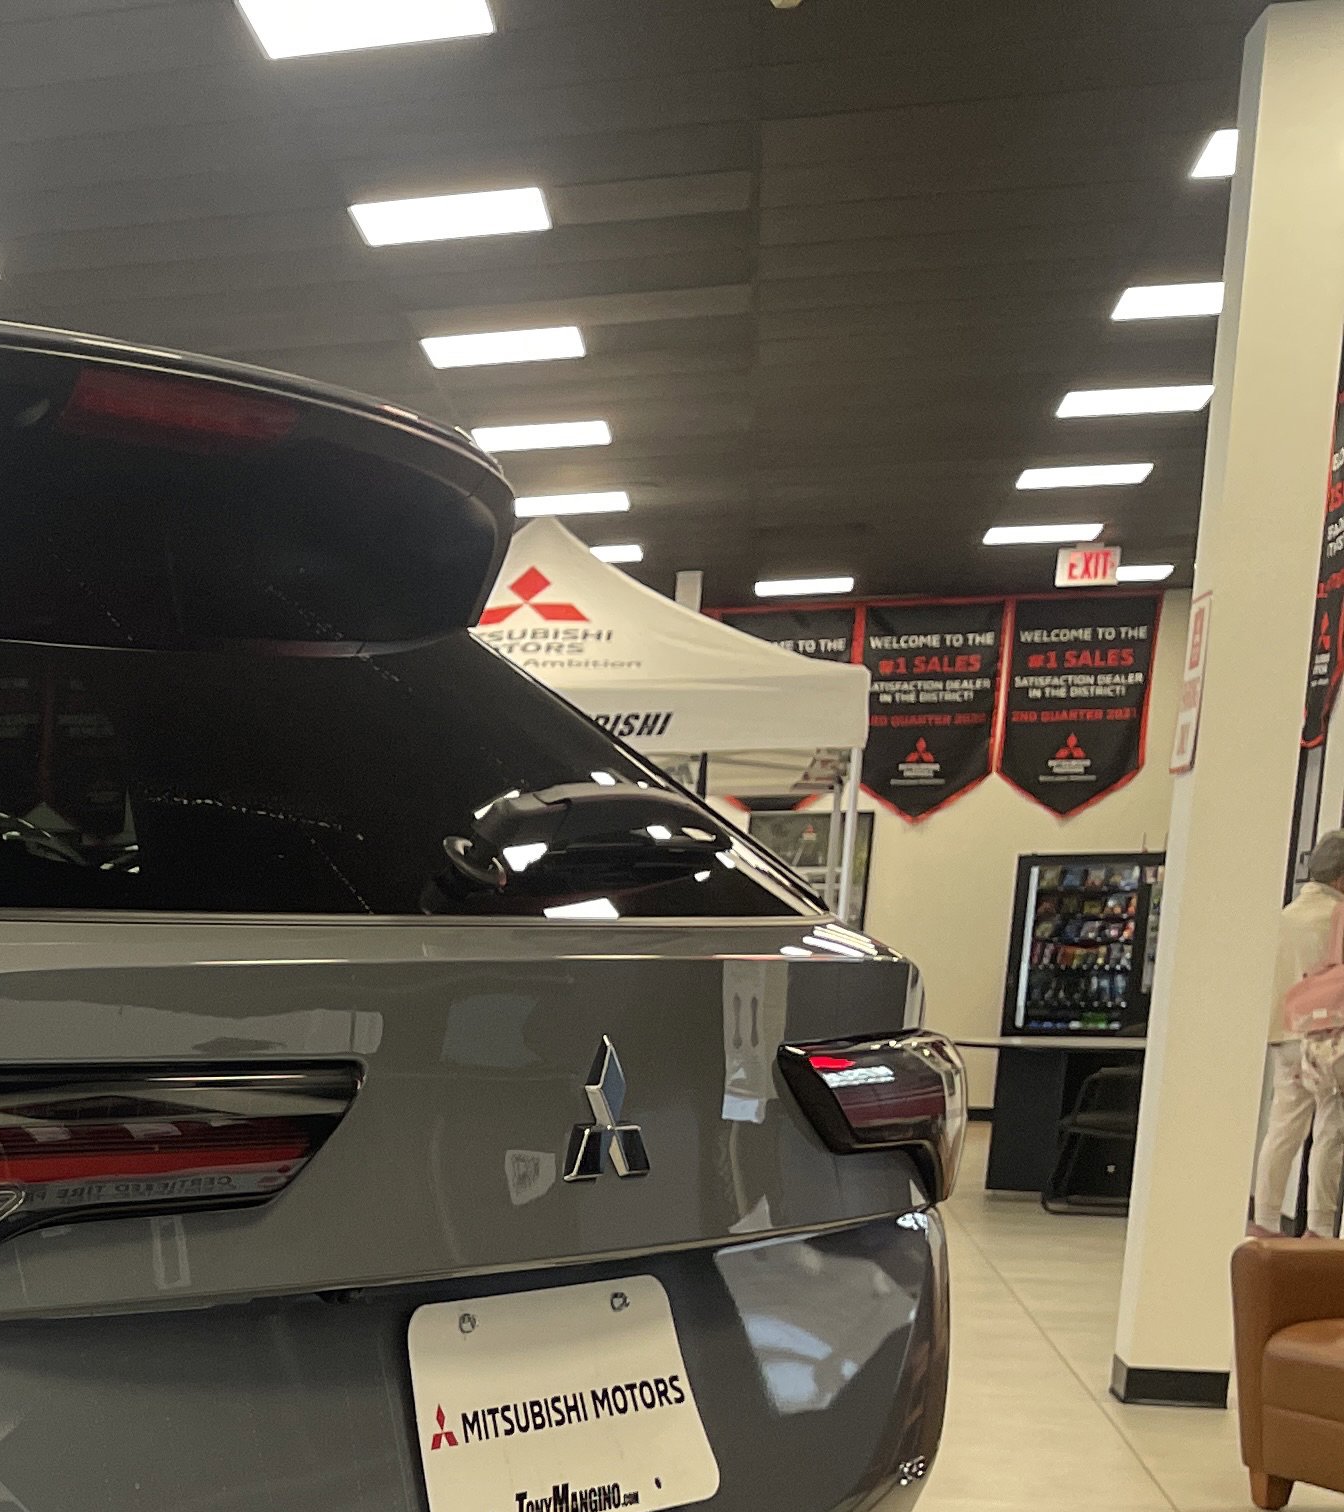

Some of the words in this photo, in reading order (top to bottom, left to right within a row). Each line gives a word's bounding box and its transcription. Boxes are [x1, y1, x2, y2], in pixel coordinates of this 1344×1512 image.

[1068, 551, 1111, 580] EXIT
[869, 634, 941, 650] WELCOME
[943, 633, 963, 648] TO
[966, 631, 995, 647] THE
[1020, 628, 1092, 644] WELCOME
[1096, 626, 1116, 641] TO
[1119, 625, 1148, 640] THE
[798, 639, 816, 653] TO
[819, 637, 847, 652] THE
[522, 657, 643, 668] Ambition
[912, 654, 982, 674] SALES
[1064, 648, 1134, 668] SALES
[870, 680, 943, 692] ATISFACTION
[1014, 674, 1095, 688] SATISFACTION
[1097, 672, 1144, 686] DEALER
[461, 1392, 589, 1444] MITSUBISHI
[590, 1374, 686, 1419] MOTORS
